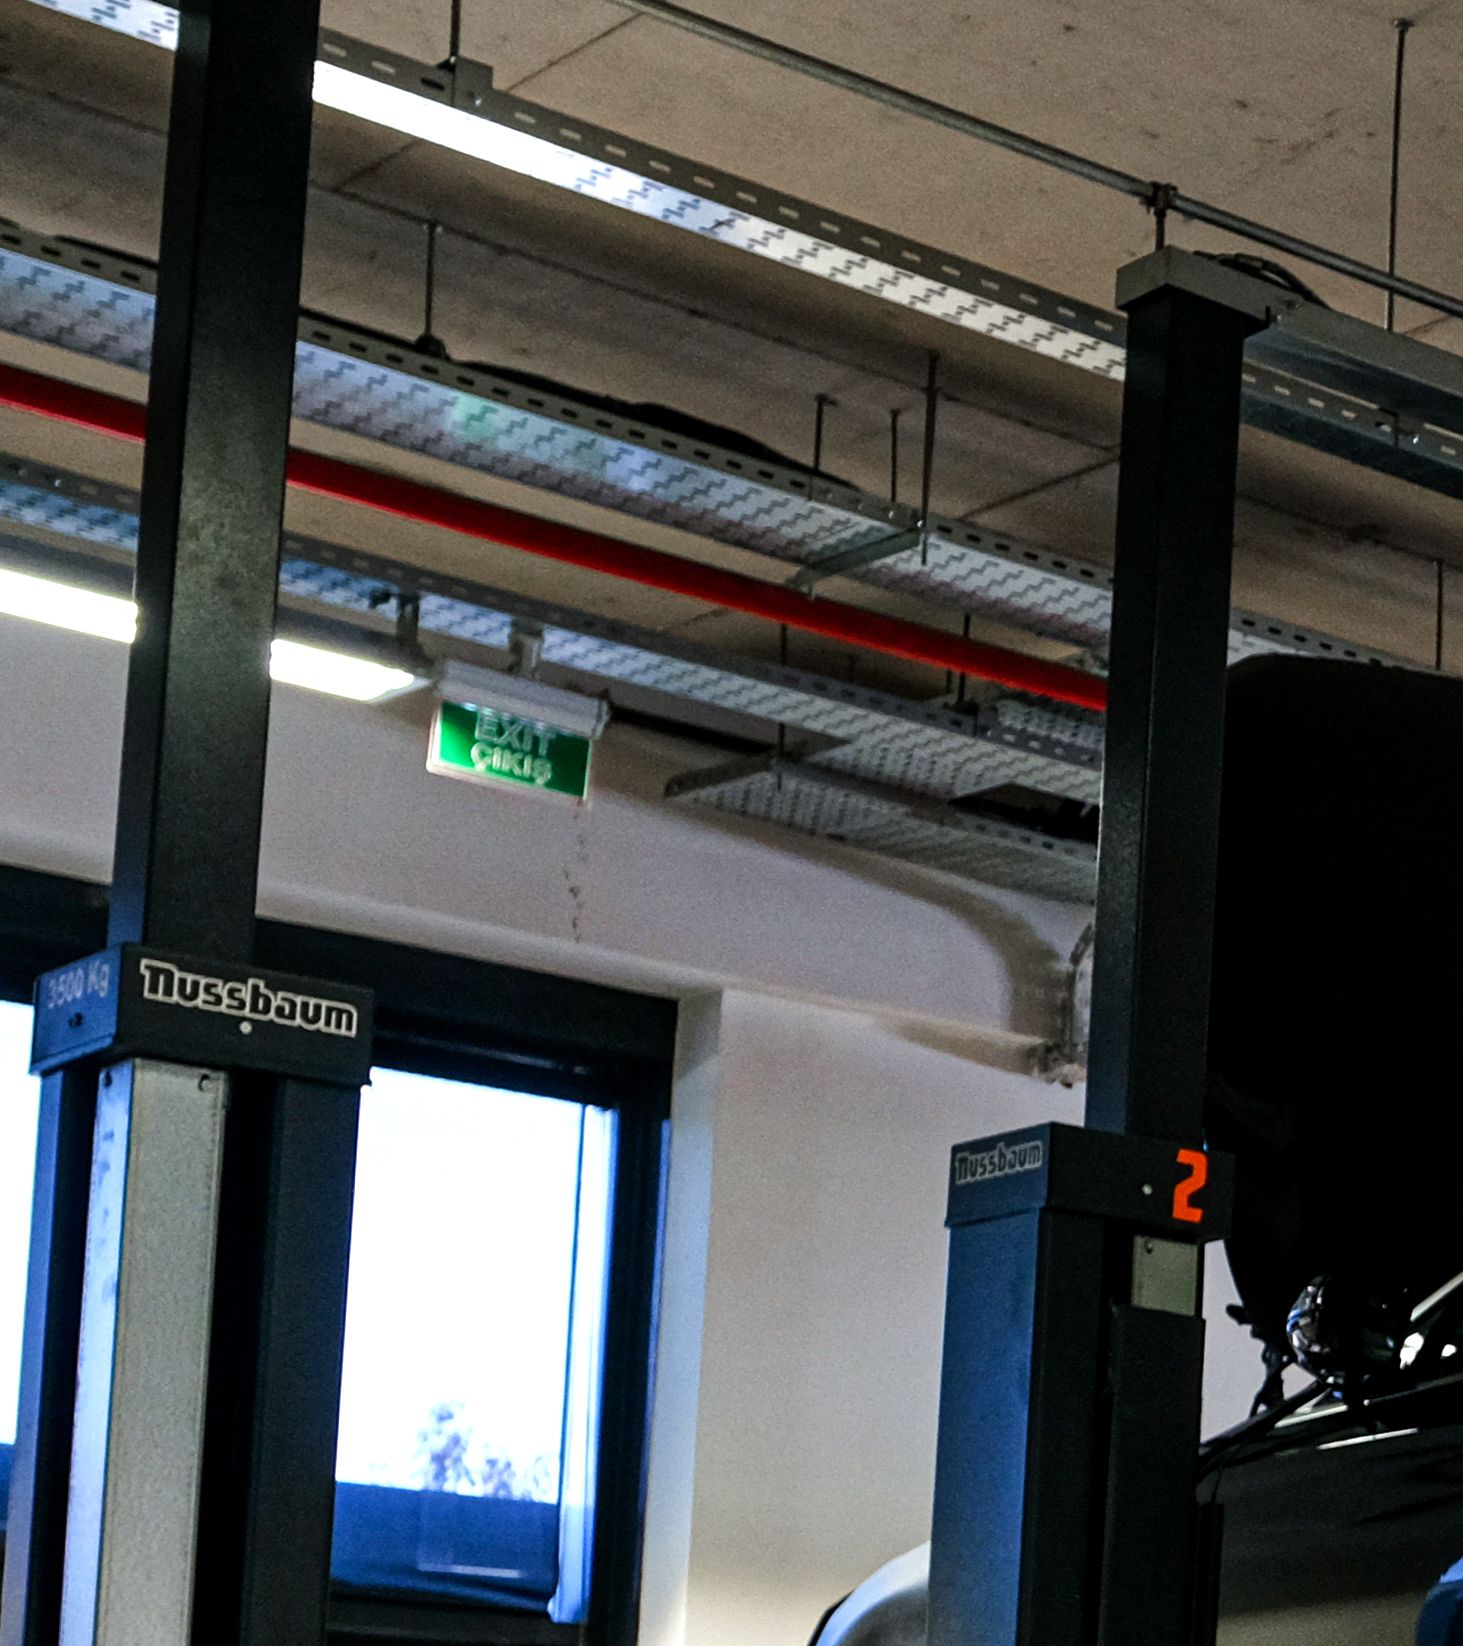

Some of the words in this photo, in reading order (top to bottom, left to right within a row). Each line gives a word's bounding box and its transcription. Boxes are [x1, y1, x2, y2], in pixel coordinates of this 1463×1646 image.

[475, 706, 557, 755] EXIT
[470, 742, 552, 784] ÇIKIŞ
[46, 967, 85, 1009] 3500
[1172, 1148, 1209, 1223] 2
